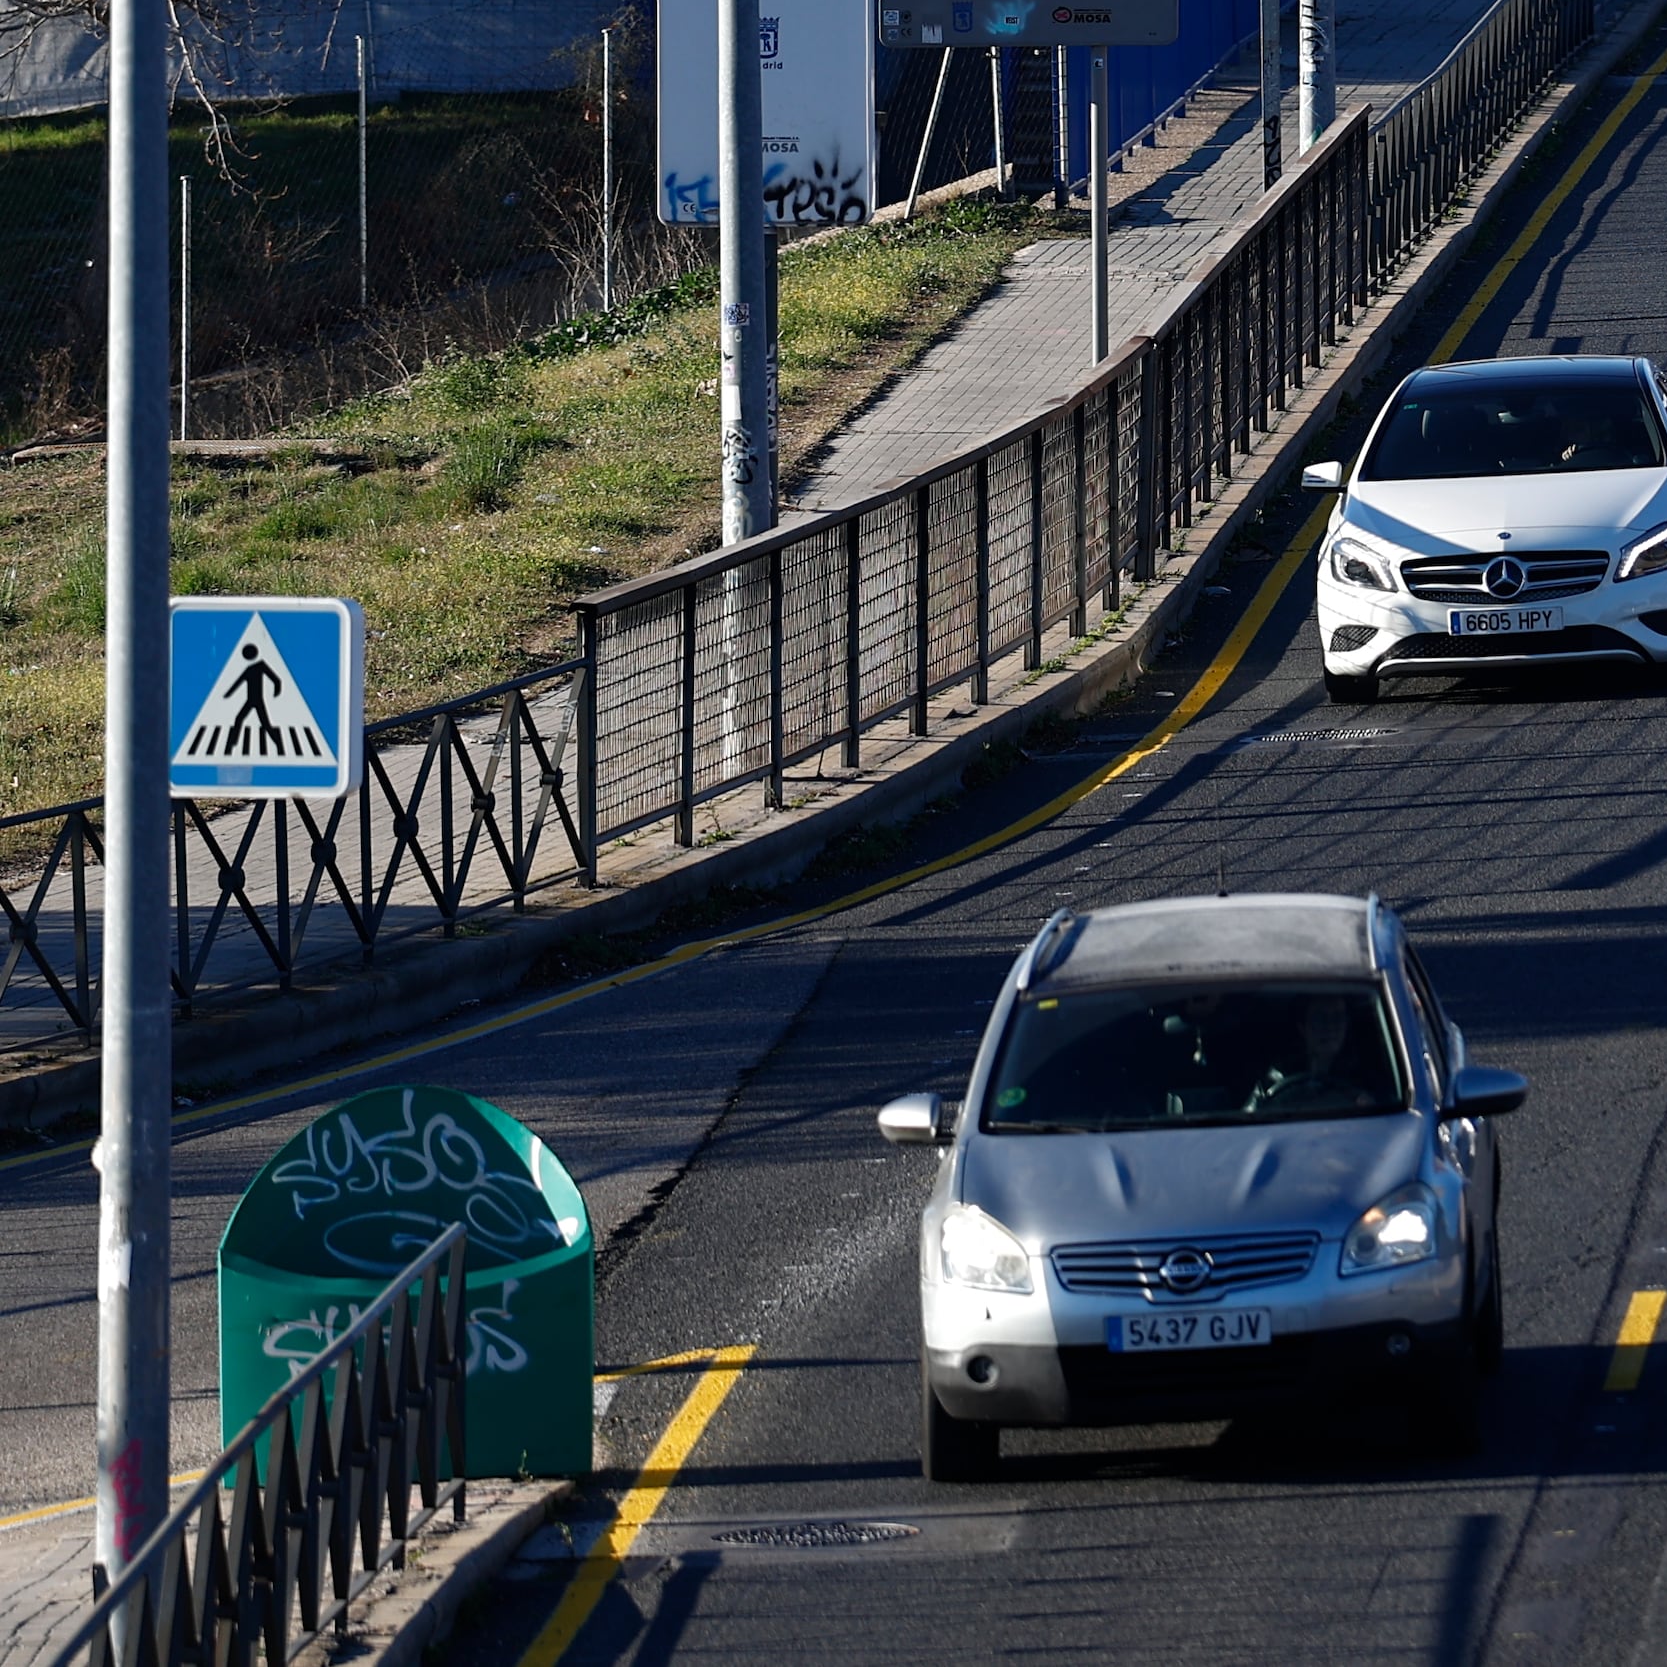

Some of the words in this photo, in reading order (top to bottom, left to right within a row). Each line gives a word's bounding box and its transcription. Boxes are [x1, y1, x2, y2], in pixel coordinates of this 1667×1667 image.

[1074, 14, 1112, 23] MOSA
[1466, 612, 1511, 632] 6605
[1518, 610, 1552, 630] HPY
[1129, 1316, 1198, 1346] 5437
[1210, 1312, 1261, 1341] GJV
